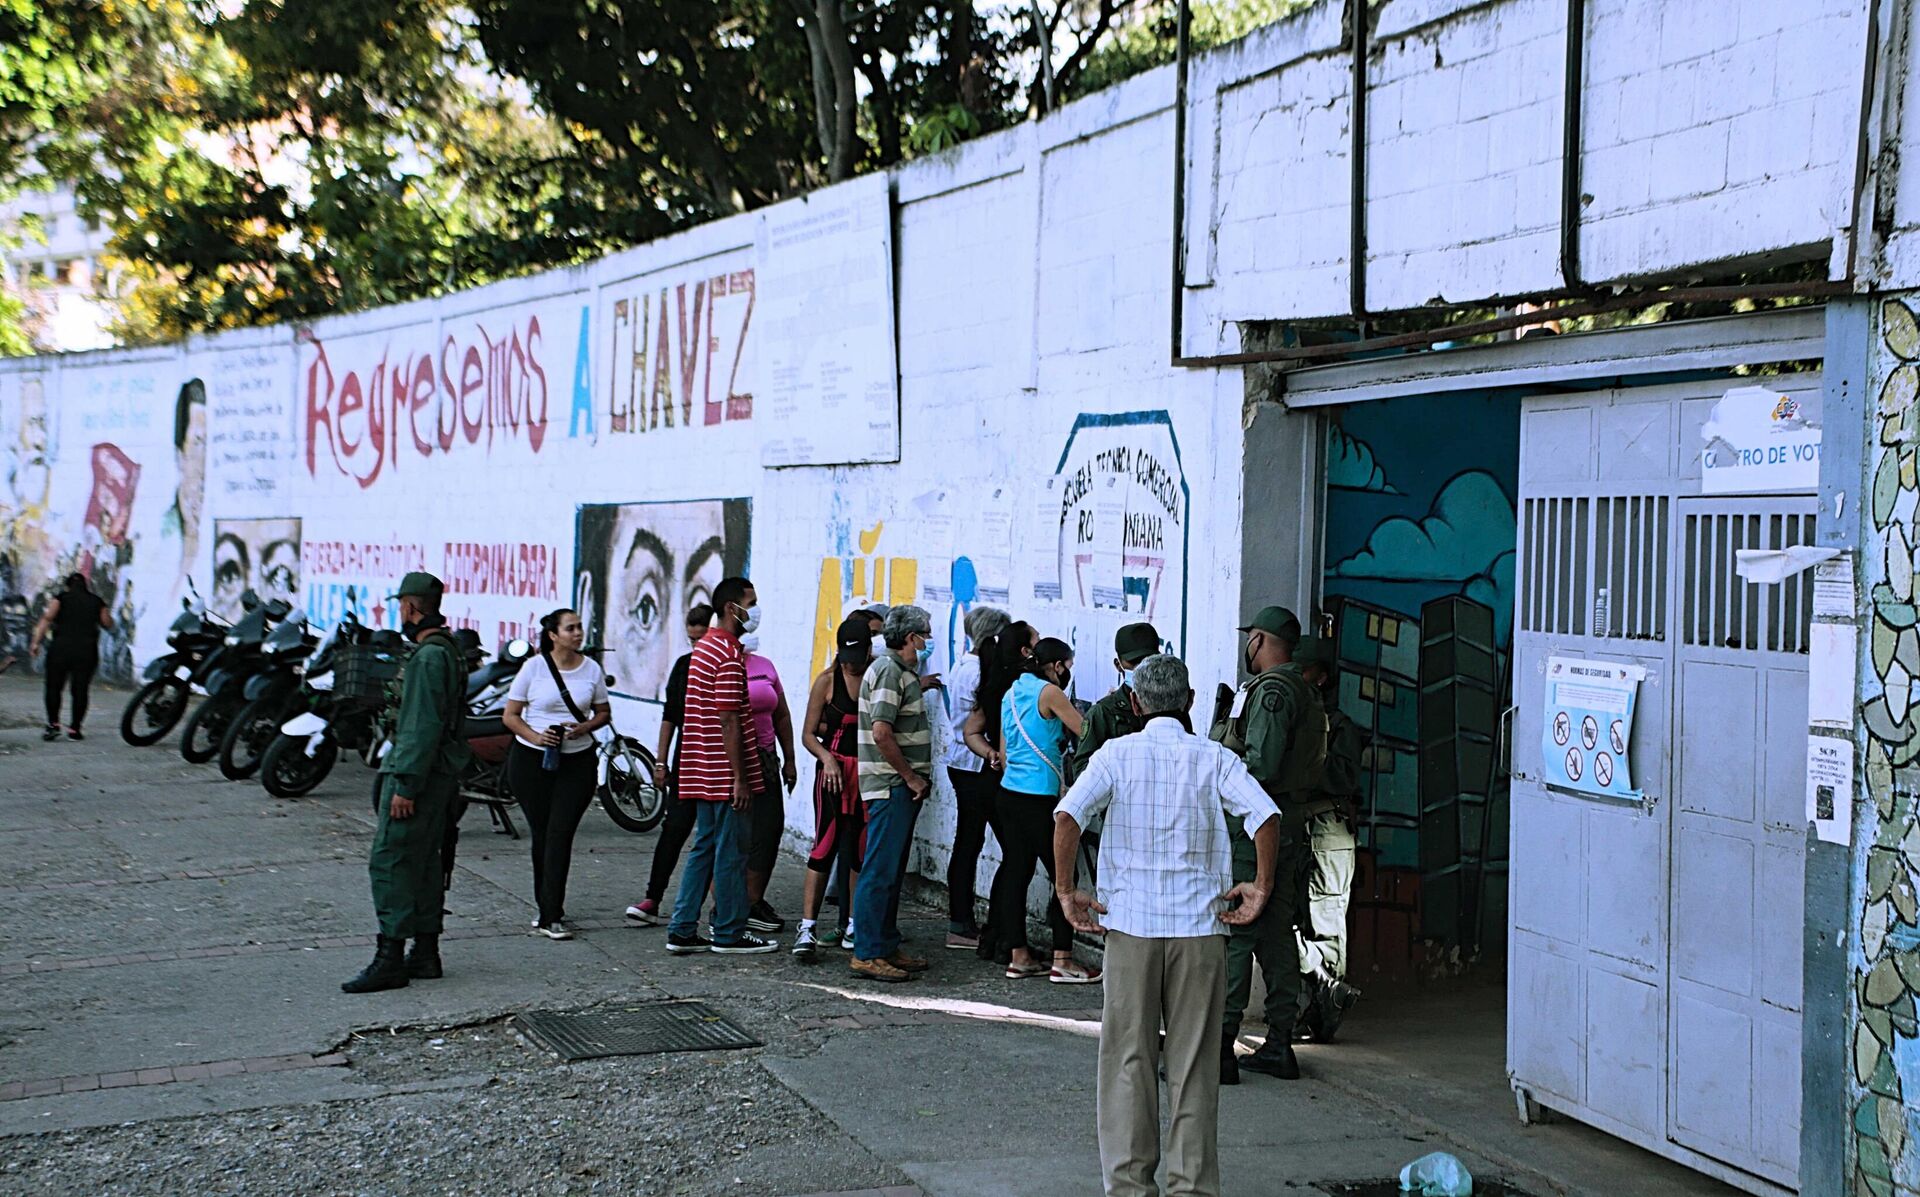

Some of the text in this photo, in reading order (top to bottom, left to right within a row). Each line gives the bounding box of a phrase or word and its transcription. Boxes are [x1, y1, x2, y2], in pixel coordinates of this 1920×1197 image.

[569, 305, 594, 438] A
[610, 268, 756, 434] CHAVEZ
[1136, 448, 1180, 527] COMERCIAL
[1704, 447, 1764, 469] CTRO
[1768, 445, 1787, 465] DE
